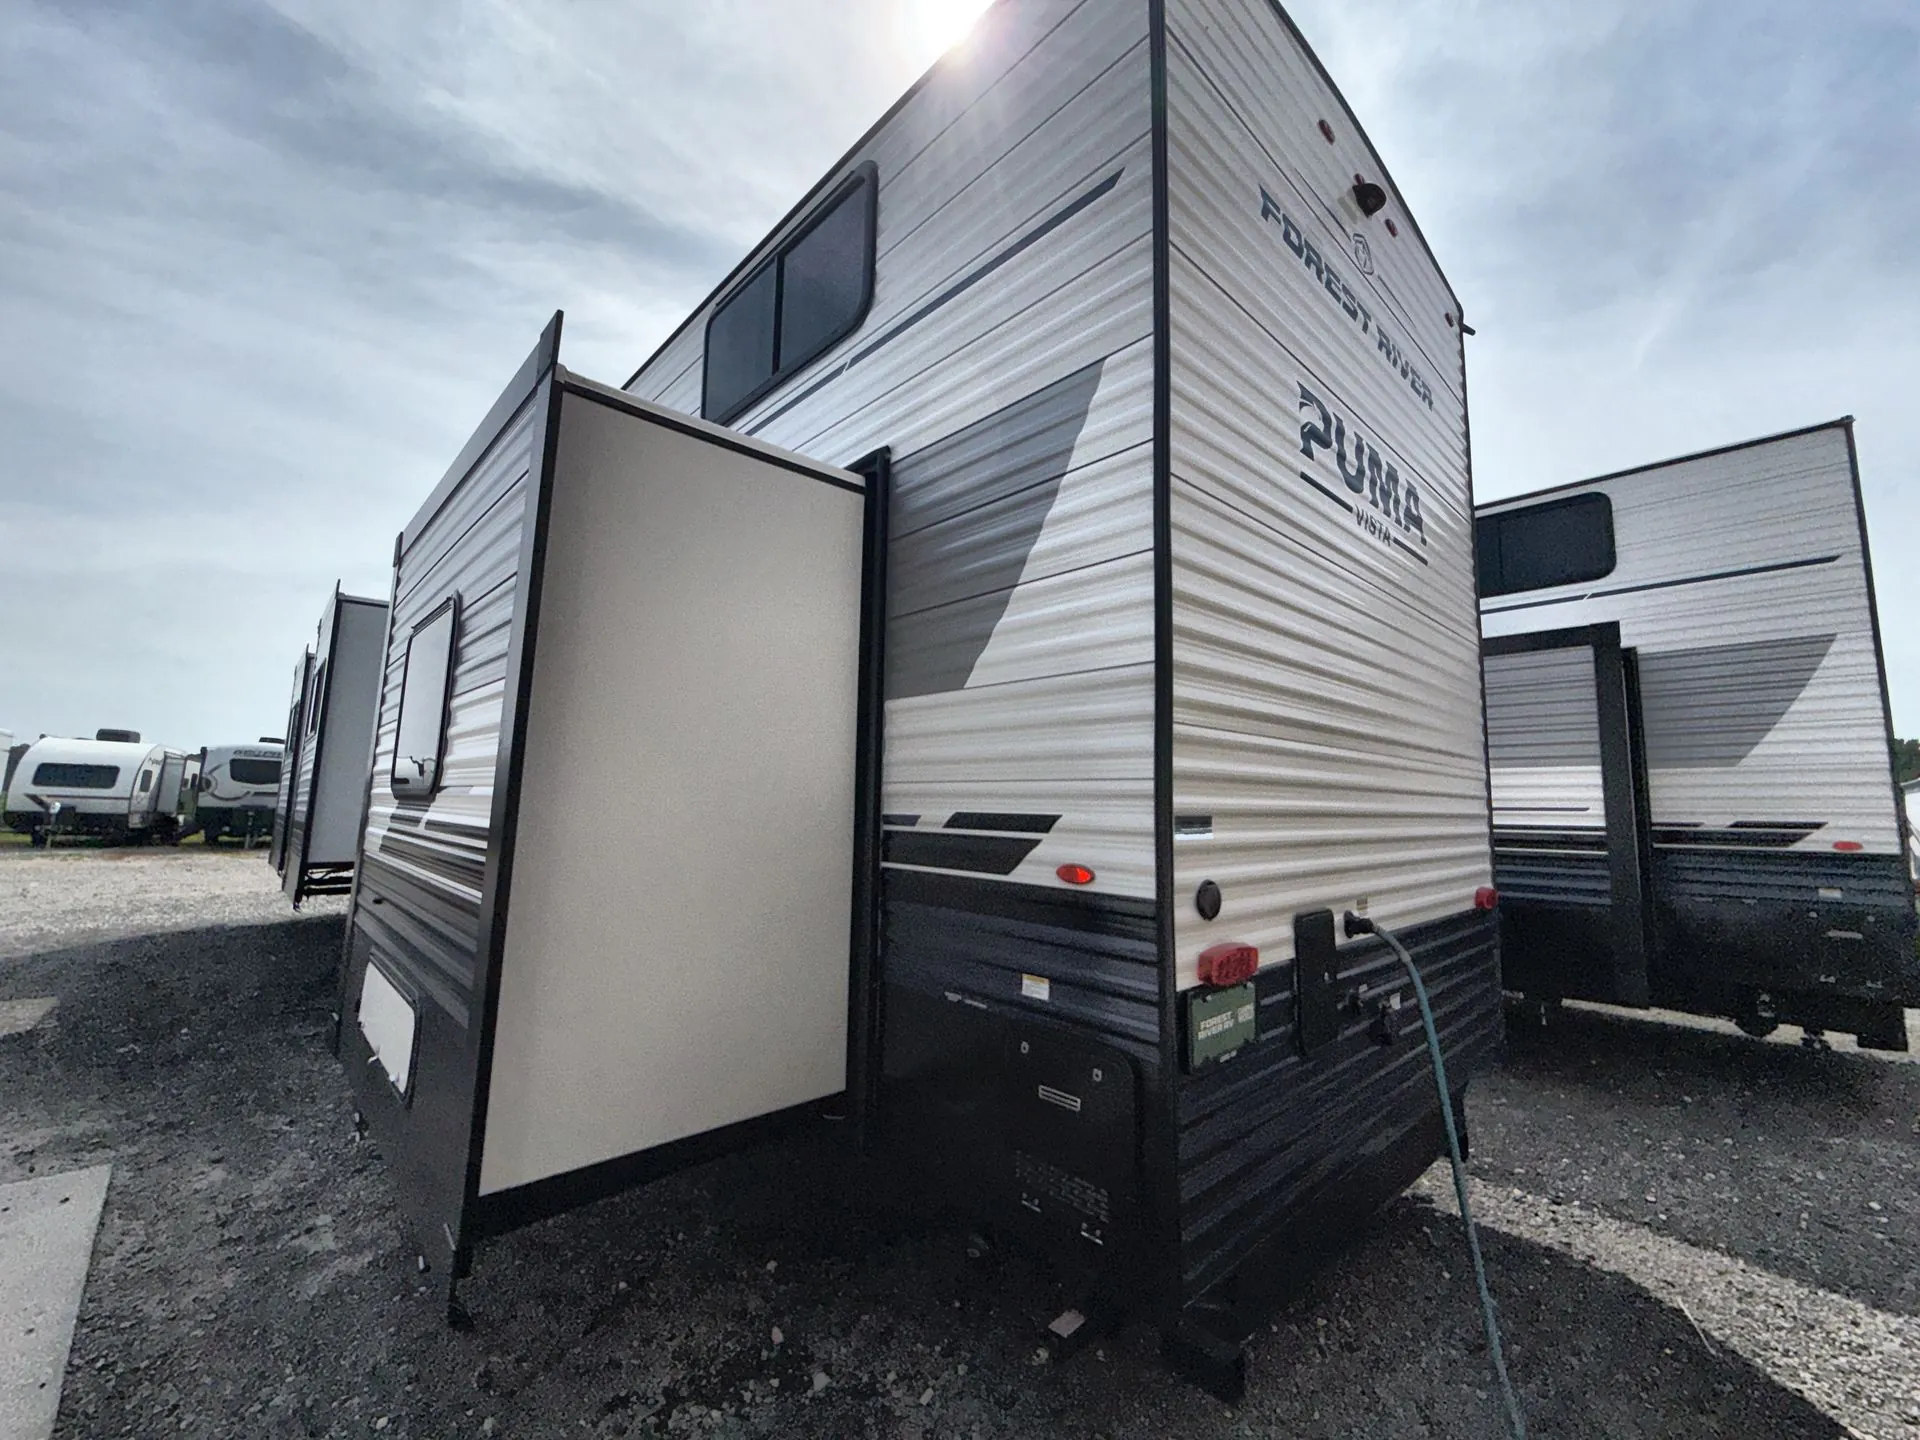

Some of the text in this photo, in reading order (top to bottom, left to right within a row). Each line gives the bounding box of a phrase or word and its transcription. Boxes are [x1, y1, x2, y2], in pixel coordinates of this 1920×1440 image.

[1259, 184, 1433, 412] FOREST RIVER
[1296, 380, 1427, 546] PUMA
[1355, 504, 1391, 547] VISTA
[1200, 1011, 1233, 1031] FOREST
